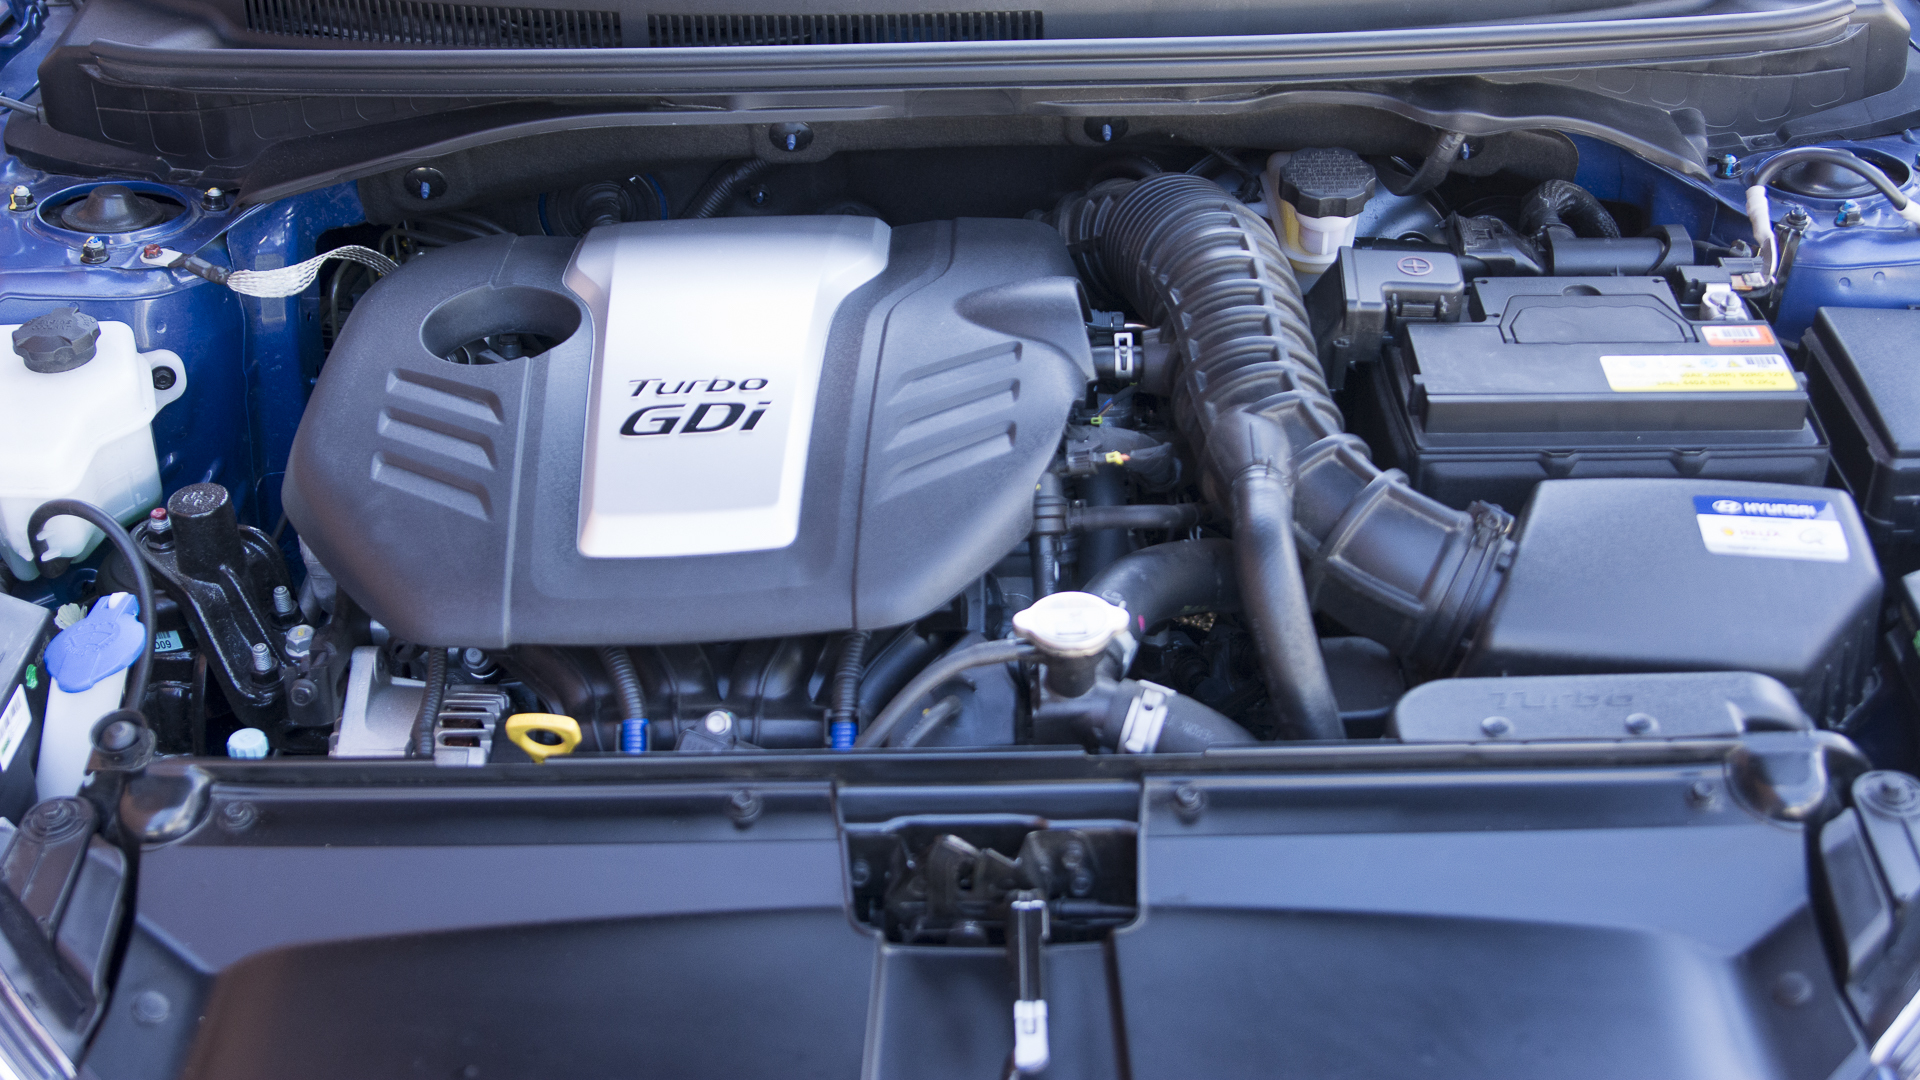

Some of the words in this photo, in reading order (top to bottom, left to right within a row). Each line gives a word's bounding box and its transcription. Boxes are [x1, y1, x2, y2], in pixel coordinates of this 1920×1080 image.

[628, 375, 769, 397] Turbo
[619, 400, 772, 436] GDi
[1743, 501, 1818, 517] HYUNDAI
